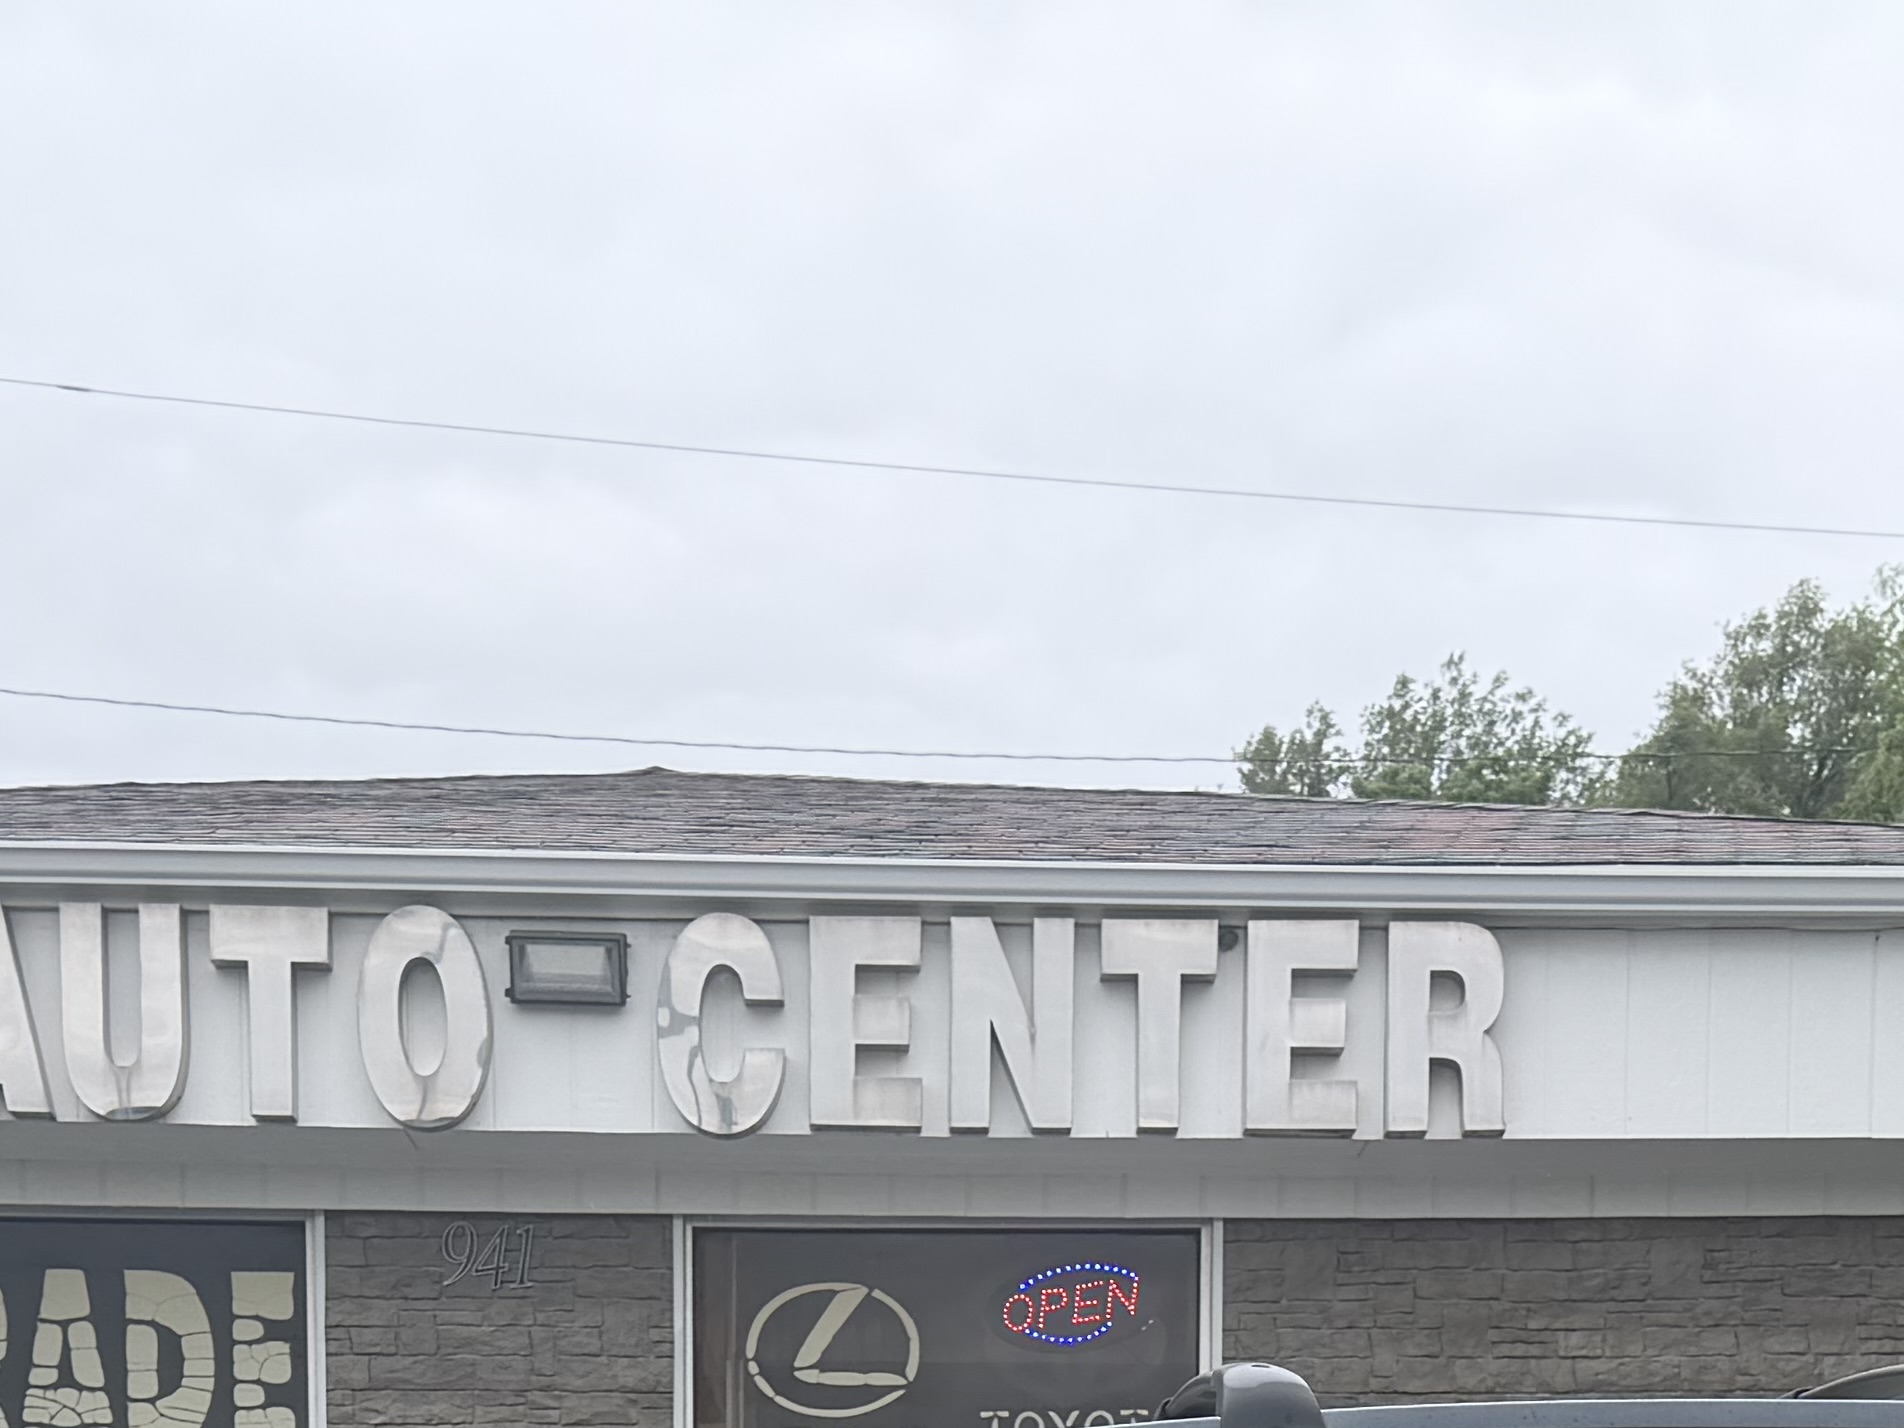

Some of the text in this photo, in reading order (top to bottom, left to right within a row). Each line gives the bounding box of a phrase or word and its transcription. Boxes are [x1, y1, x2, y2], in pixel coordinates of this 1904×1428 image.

[657, 912, 1505, 1139] CENTER
[441, 1220, 535, 1291] 941
[1003, 1279, 1139, 1332] OPEN
